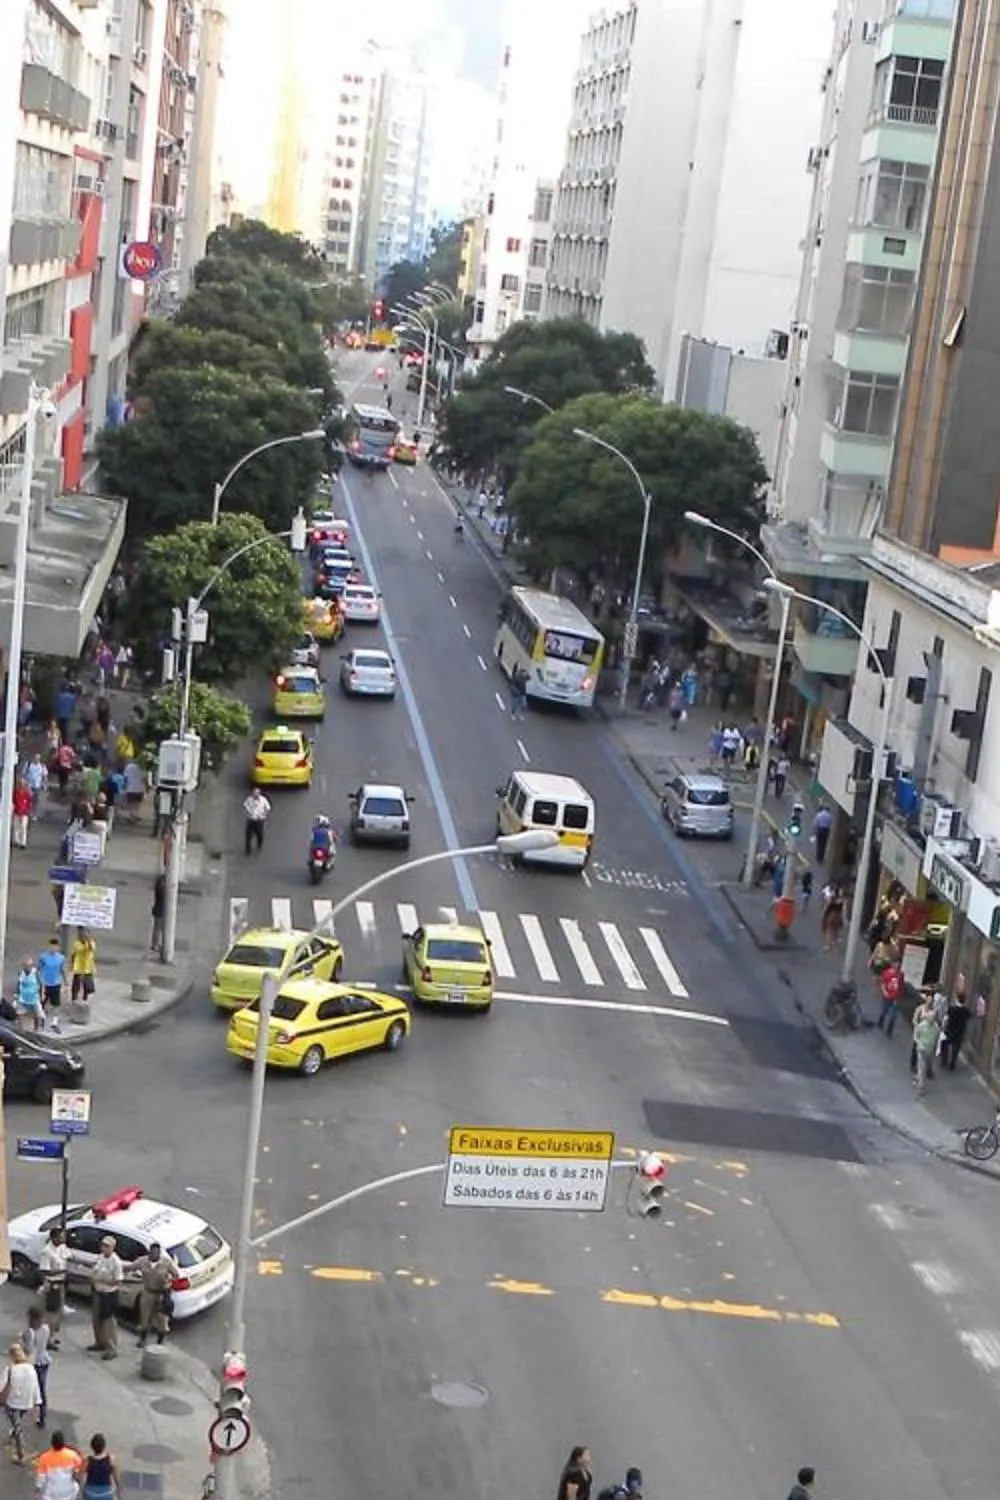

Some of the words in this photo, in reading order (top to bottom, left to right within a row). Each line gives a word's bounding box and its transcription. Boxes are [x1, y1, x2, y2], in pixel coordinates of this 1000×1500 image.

[459, 1134, 512, 1150] Faixas
[517, 1136, 603, 1153] Exclusivas
[453, 1161, 481, 1175] Dias
[485, 1160, 518, 1177] Úteis
[523, 1165, 546, 1177] das
[549, 1166, 558, 1178] 6
[580, 1167, 604, 1180] 21h
[453, 1184, 513, 1199] Sábados
[515, 1188, 540, 1201] das
[543, 1189, 552, 1201] 6
[575, 1190, 599, 1201] 14h
